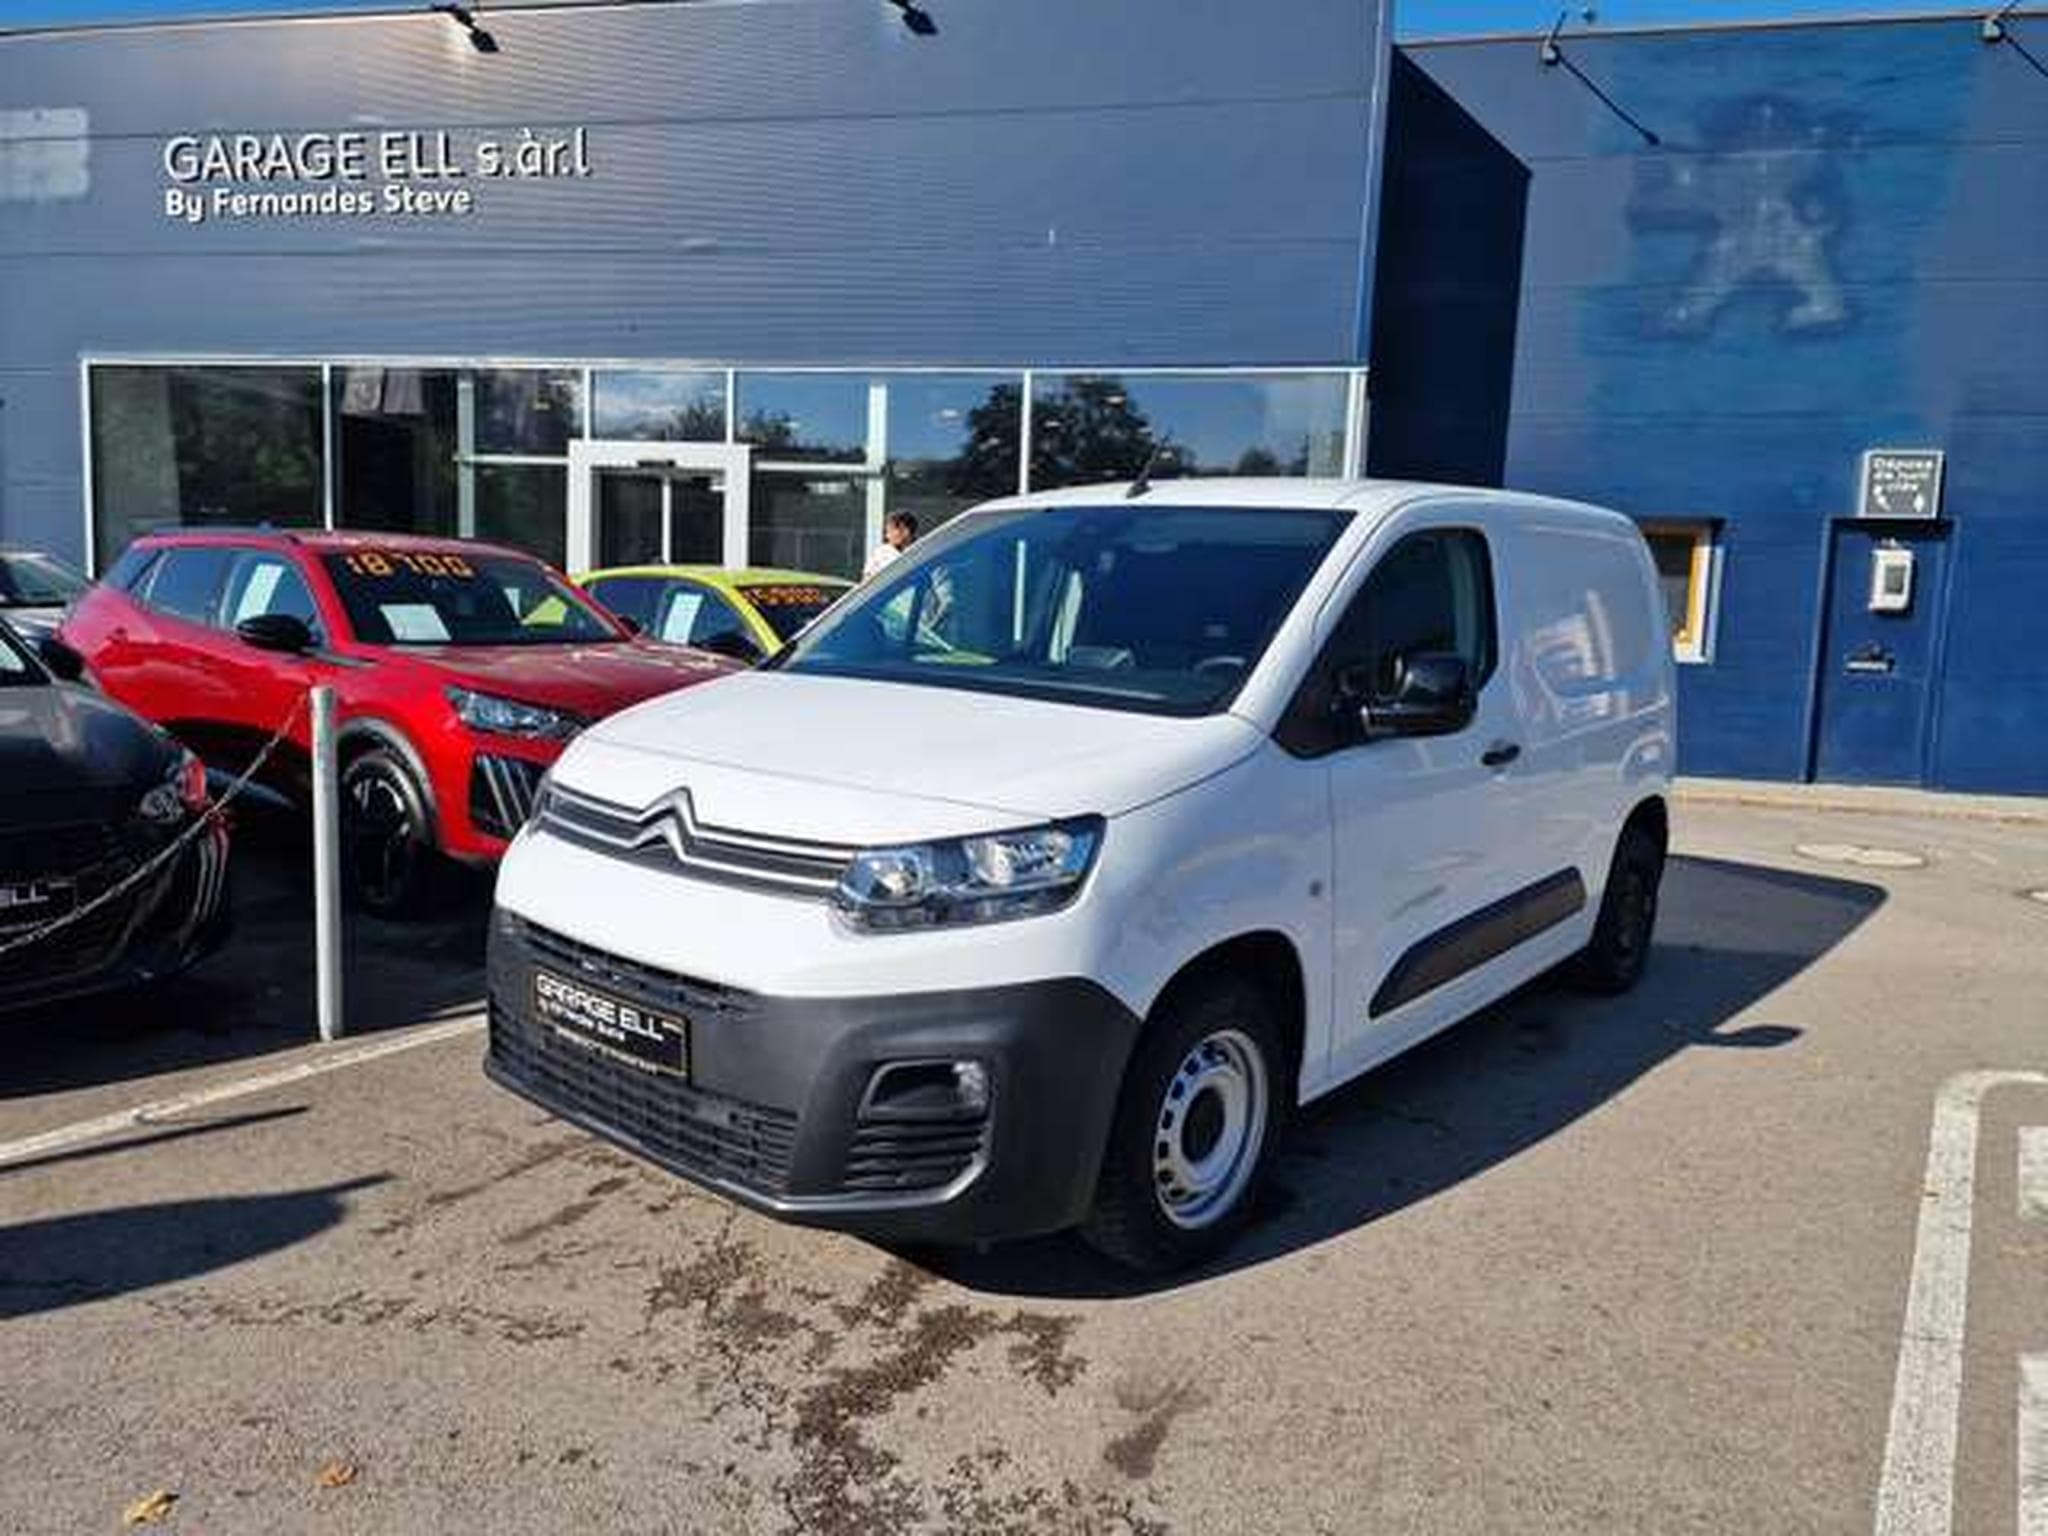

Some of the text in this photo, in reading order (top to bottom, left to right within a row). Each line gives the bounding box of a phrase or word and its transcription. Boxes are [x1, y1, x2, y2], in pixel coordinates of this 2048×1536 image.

[163, 132, 366, 182] GARAGE
[379, 130, 464, 178] ELL
[165, 184, 472, 222] By Fernandes Steve
